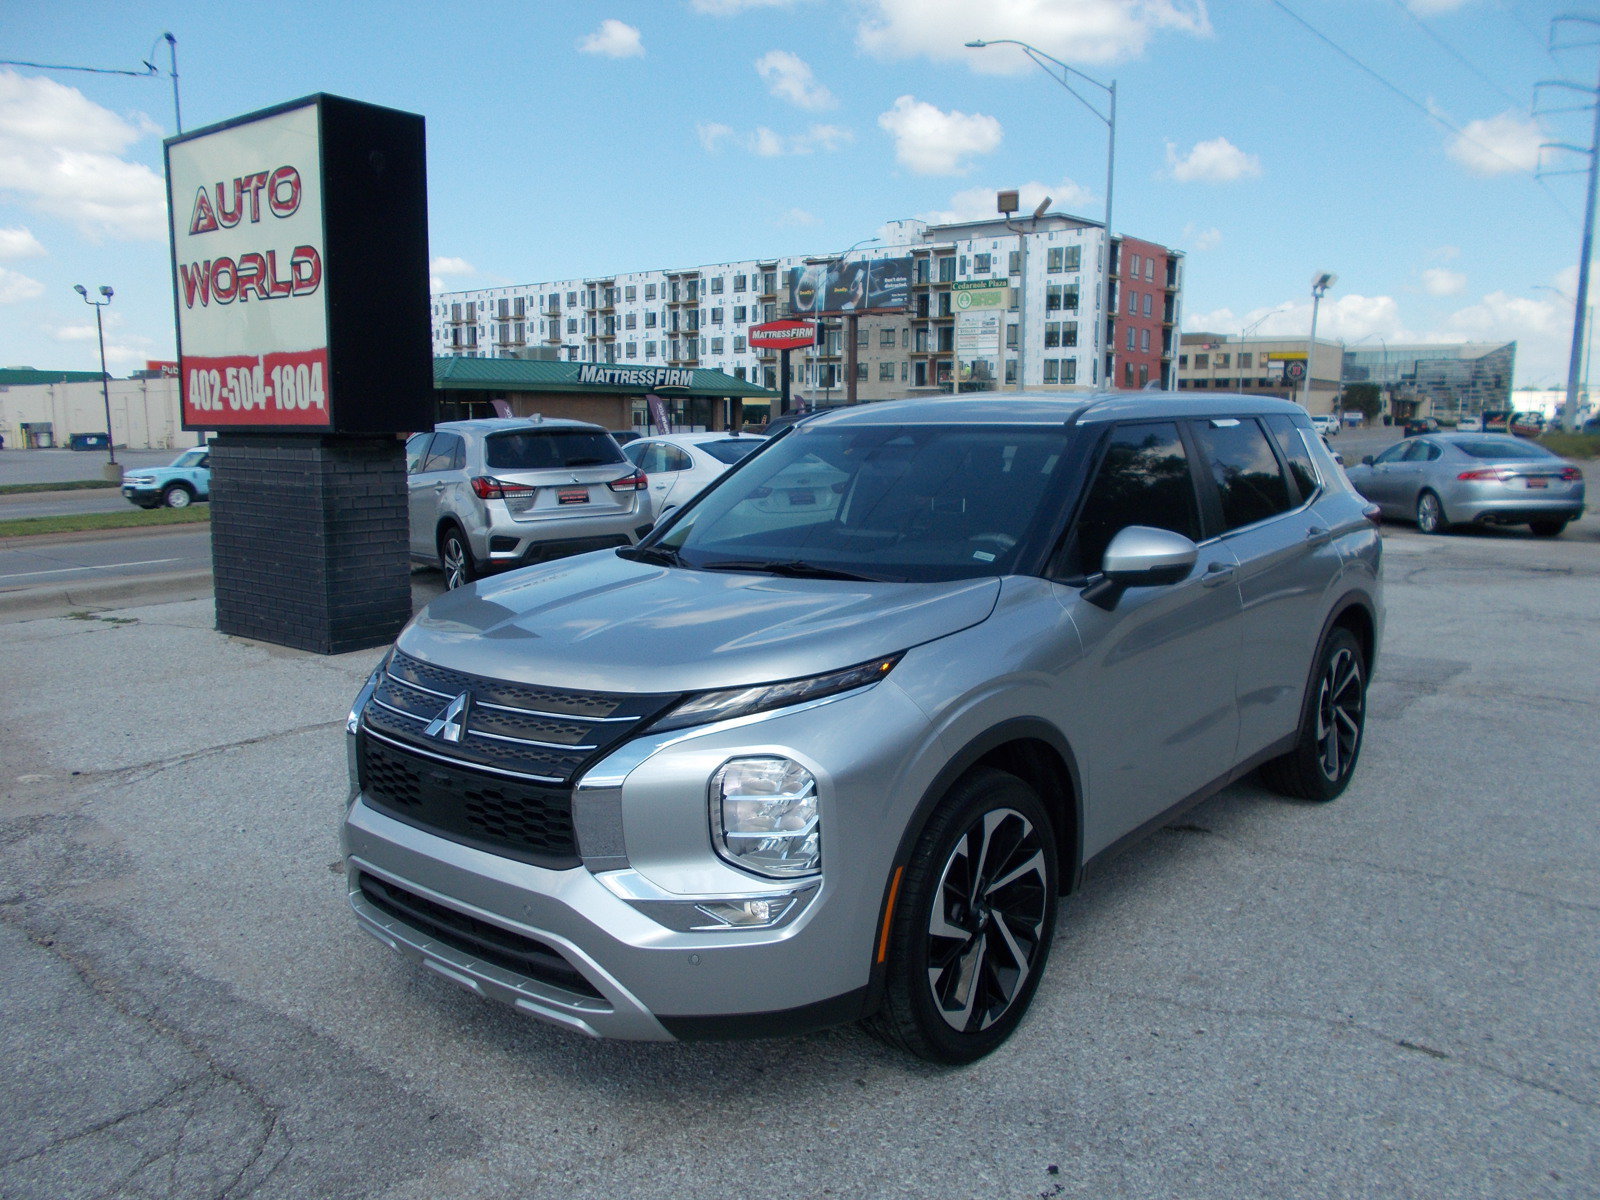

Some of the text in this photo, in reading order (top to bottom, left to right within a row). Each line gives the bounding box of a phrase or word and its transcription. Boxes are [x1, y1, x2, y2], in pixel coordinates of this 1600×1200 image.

[189, 165, 302, 236] AUTO
[180, 245, 322, 309] WORLD
[988, 279, 1007, 288] Plaza
[189, 361, 325, 411] 402-504-1804
